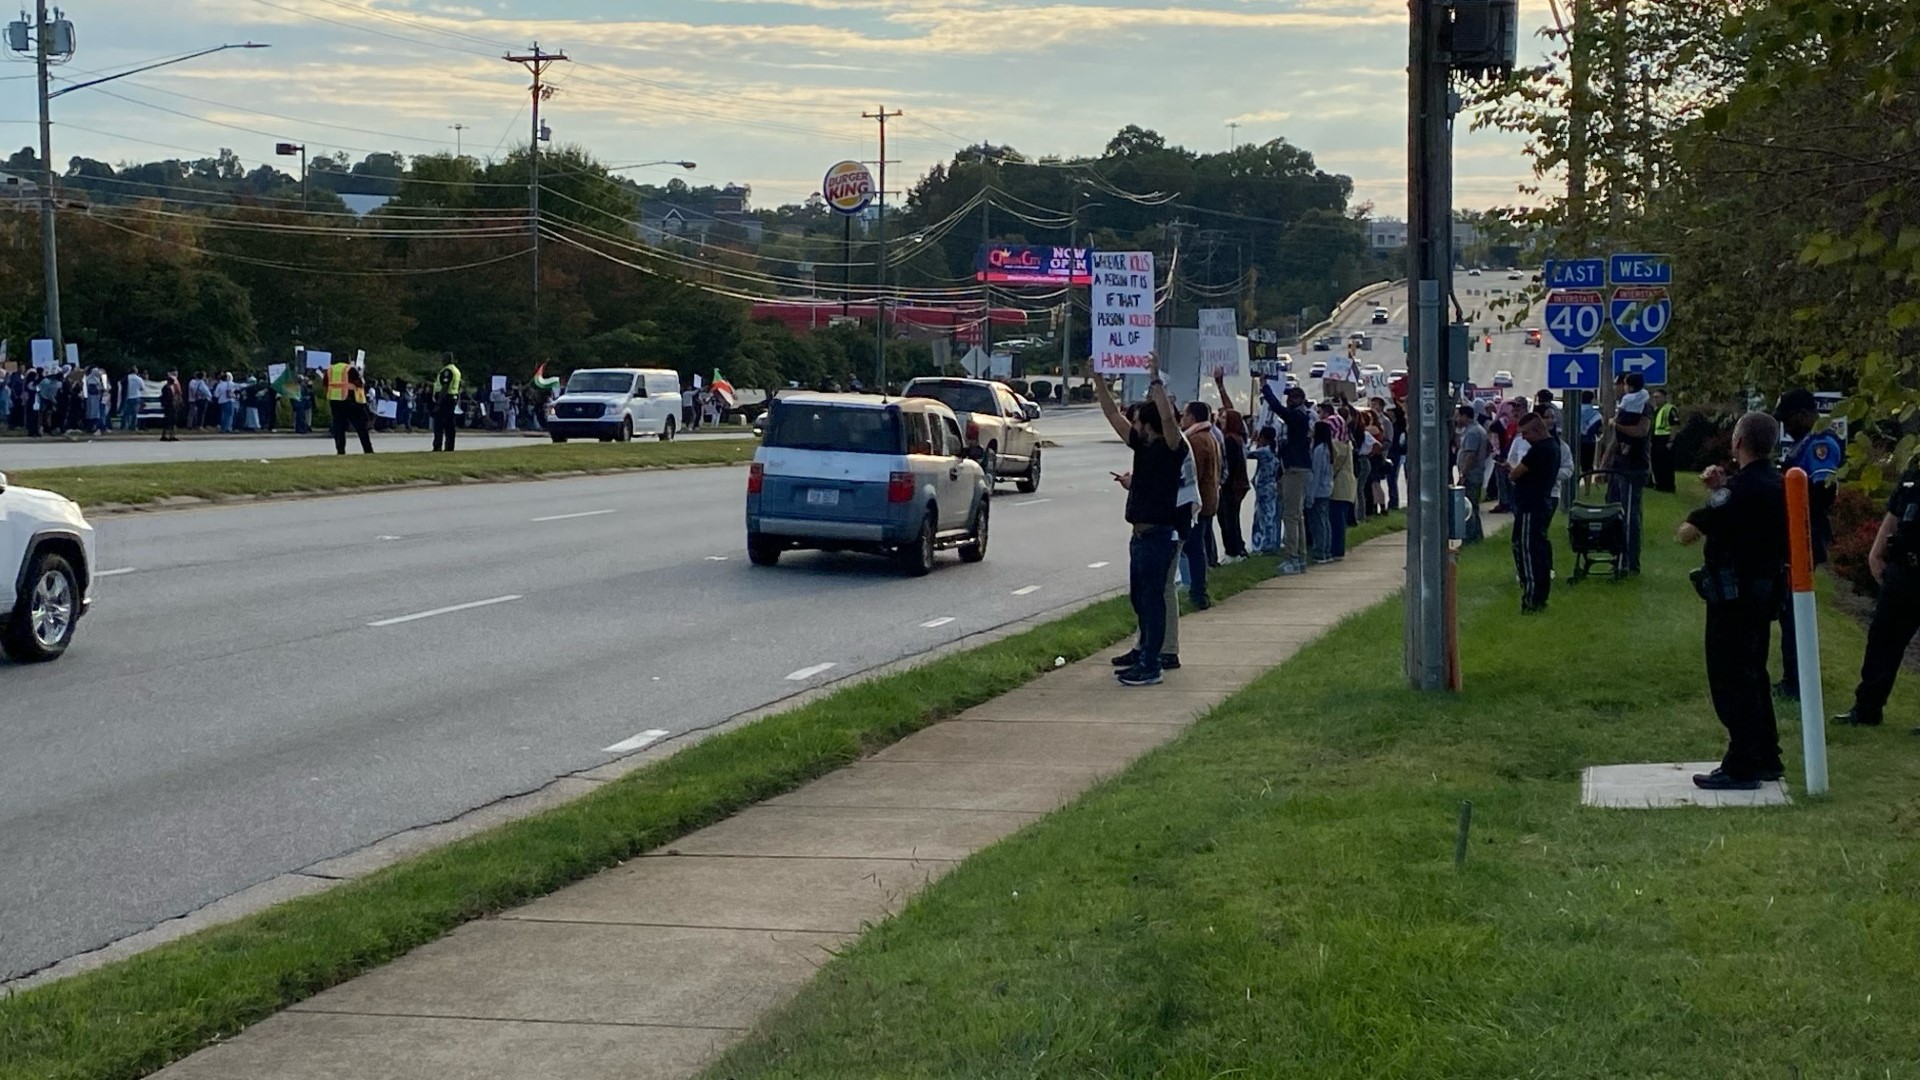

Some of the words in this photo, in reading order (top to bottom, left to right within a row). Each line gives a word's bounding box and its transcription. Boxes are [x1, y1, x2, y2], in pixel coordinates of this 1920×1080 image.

[829, 172, 869, 187] BURGER
[830, 182, 869, 200] KING
[1053, 247, 1086, 259] NOW
[1050, 259, 1087, 269] OPN
[1620, 261, 1663, 277] WEST
[1094, 274, 1101, 285] A
[1105, 273, 1128, 287] PERSON
[1131, 275, 1138, 288] IT
[1140, 275, 1148, 289] IS
[1553, 265, 1596, 283] EAST
[1117, 293, 1142, 308] THAT
[1553, 295, 1595, 303] INTERSTATE
[1620, 290, 1658, 299] INTERSTA
[1098, 312, 1125, 327] PERSON
[1550, 306, 1599, 337] 40
[1616, 301, 1665, 333] 40
[1109, 332, 1124, 347] ALL
[1128, 331, 1140, 345] OF
